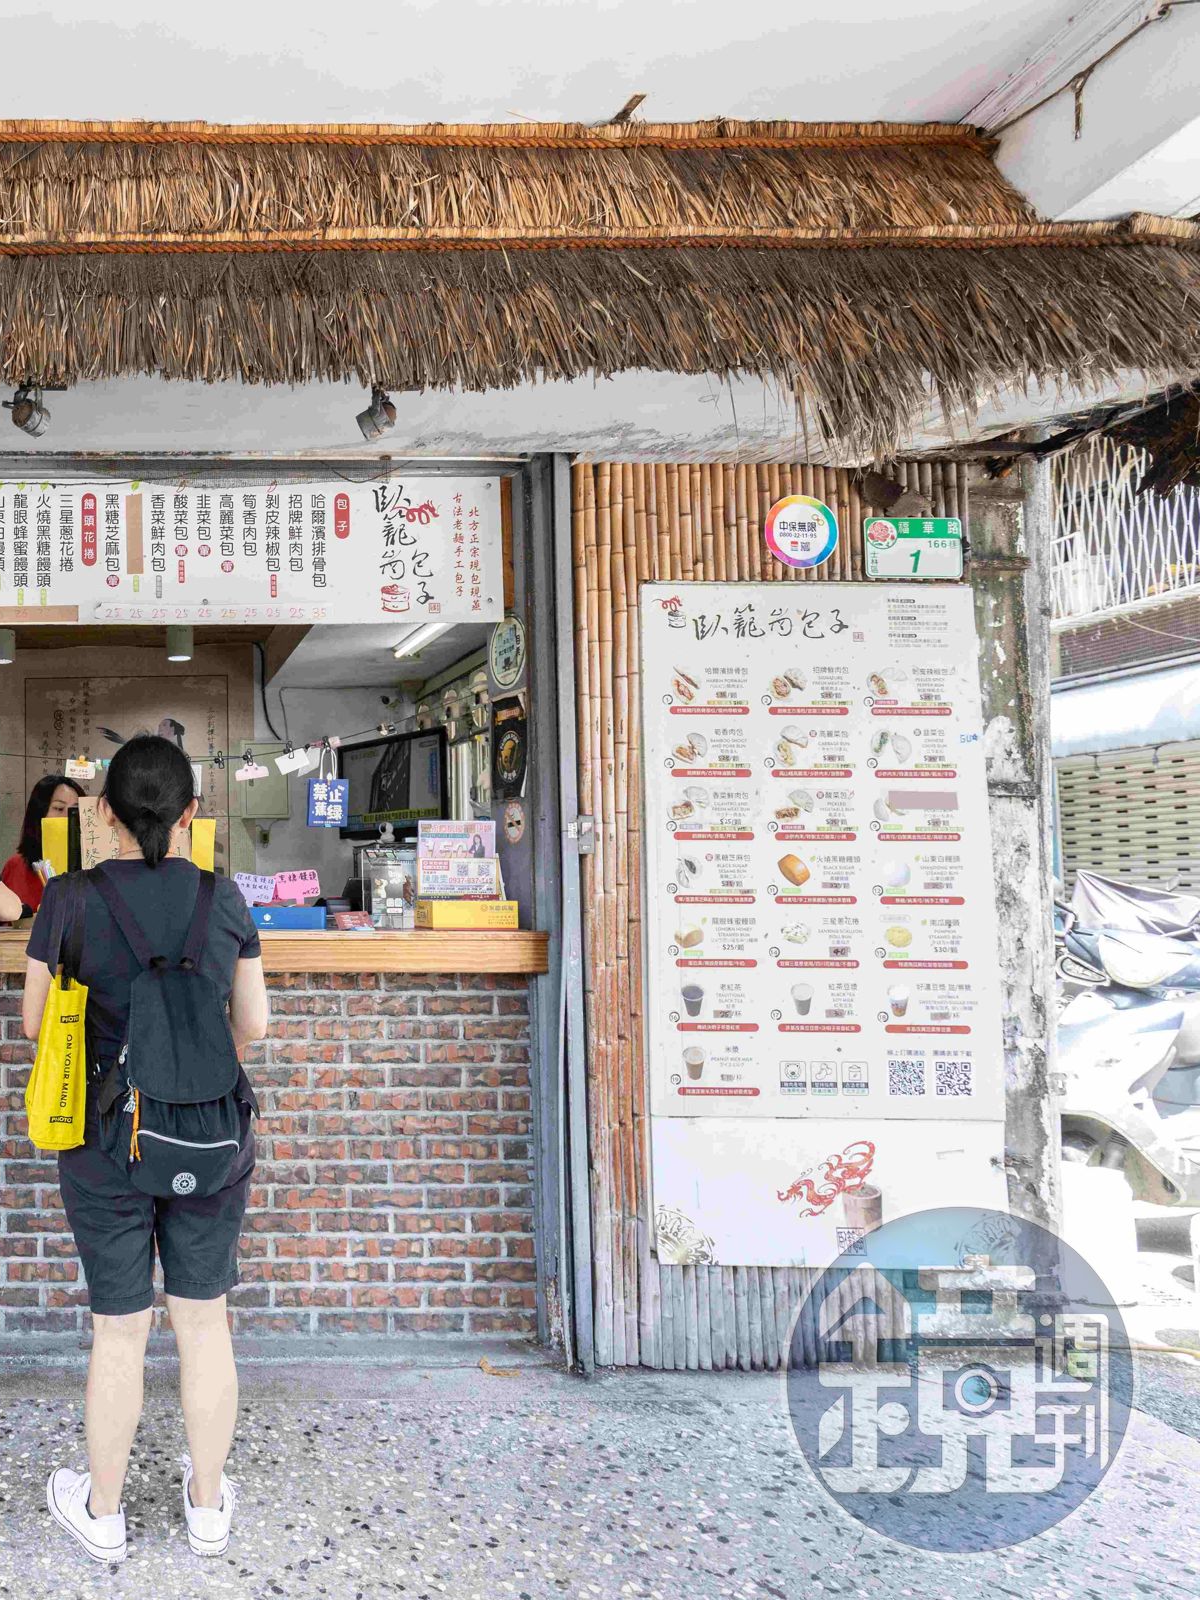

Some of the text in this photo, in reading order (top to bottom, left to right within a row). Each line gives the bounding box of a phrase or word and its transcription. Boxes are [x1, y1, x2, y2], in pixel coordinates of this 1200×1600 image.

[13, 494, 28, 588] 龍眼蜂蜜饅頭
[36, 494, 51, 588] 火燒黑糖饅頭
[83, 498, 95, 560] 饅頭花捲
[104, 493, 120, 572] 黑糖芝麻包
[150, 493, 166, 572] 香菜鮮肉包
[173, 493, 189, 541] 酸菜包
[196, 493, 212, 541] 韭菜包
[219, 493, 235, 557] 高麗菜包
[242, 493, 258, 557] 筍香肉包
[287, 493, 304, 572] 招牌鮮肉包
[311, 493, 327, 588] 哈爾濱排骨包
[336, 498, 348, 532] 包子
[779, 521, 817, 533] 中保無限
[898, 521, 960, 534] 福華路
[909, 550, 921, 573] 1
[59, 1034, 73, 1108] ON YOUR MIND
